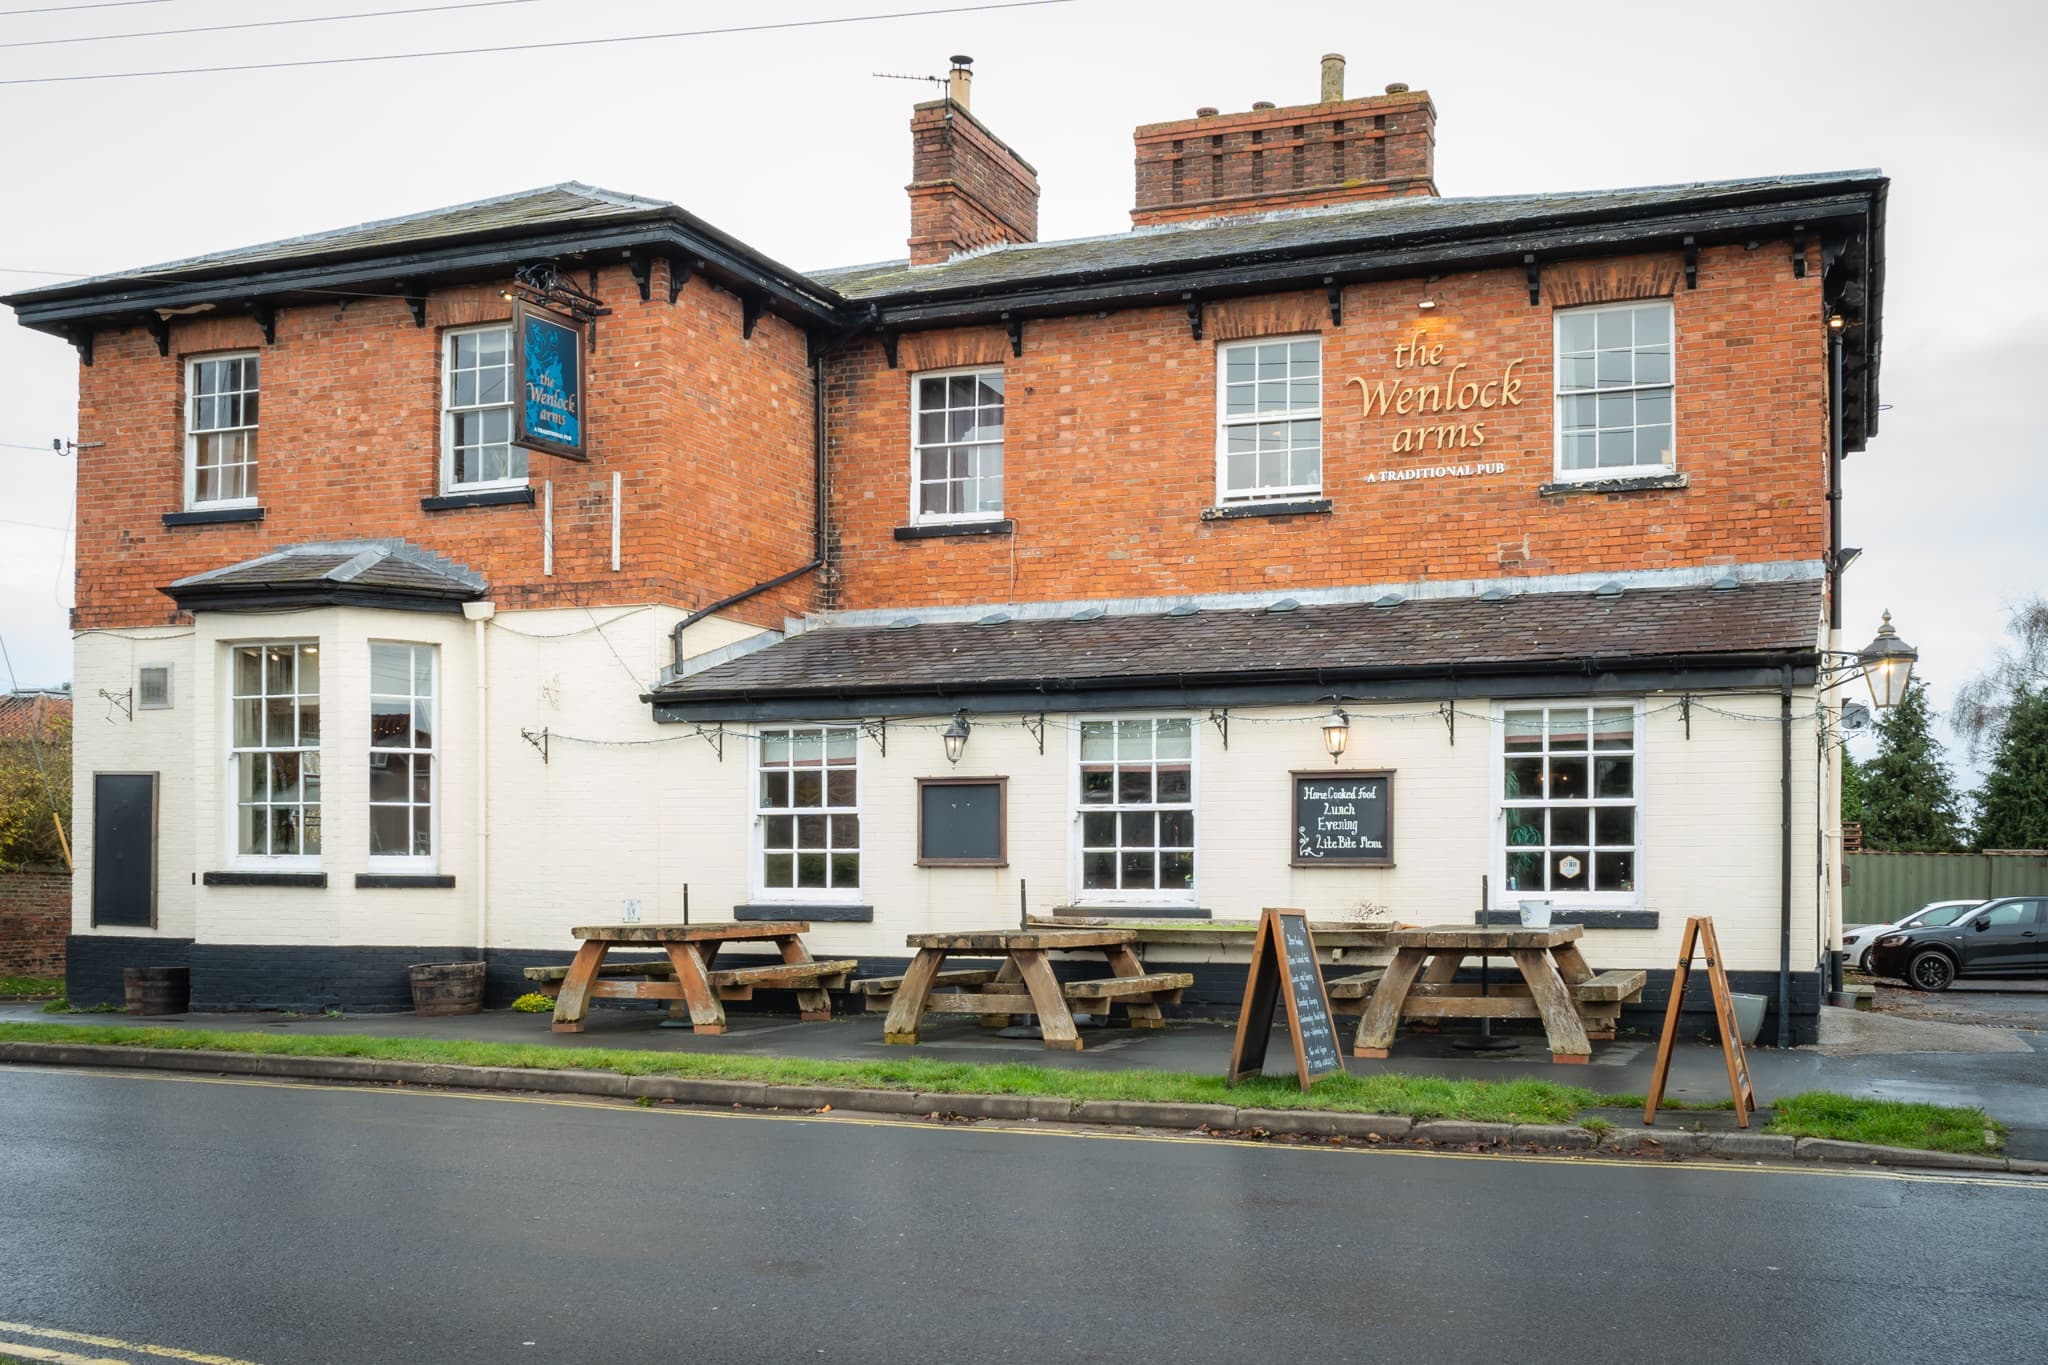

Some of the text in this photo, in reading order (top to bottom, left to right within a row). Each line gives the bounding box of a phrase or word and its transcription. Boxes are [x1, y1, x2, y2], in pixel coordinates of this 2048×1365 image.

[1394, 329, 1444, 369] the
[540, 371, 555, 387] the
[1346, 358, 1524, 417] Wenlock
[526, 383, 576, 412] Wenlock
[539, 409, 566, 426] arms
[1392, 422, 1487, 453] arms
[1366, 462, 1506, 483] A TRADITIONAL PUB
[1303, 786, 1328, 800] Home
[1328, 786, 1358, 800] Cooked
[1323, 802, 1356, 815] Lunch
[1318, 816, 1358, 835] Evening
[1338, 835, 1357, 849] Bite
[1359, 836, 1383, 849] Menu
